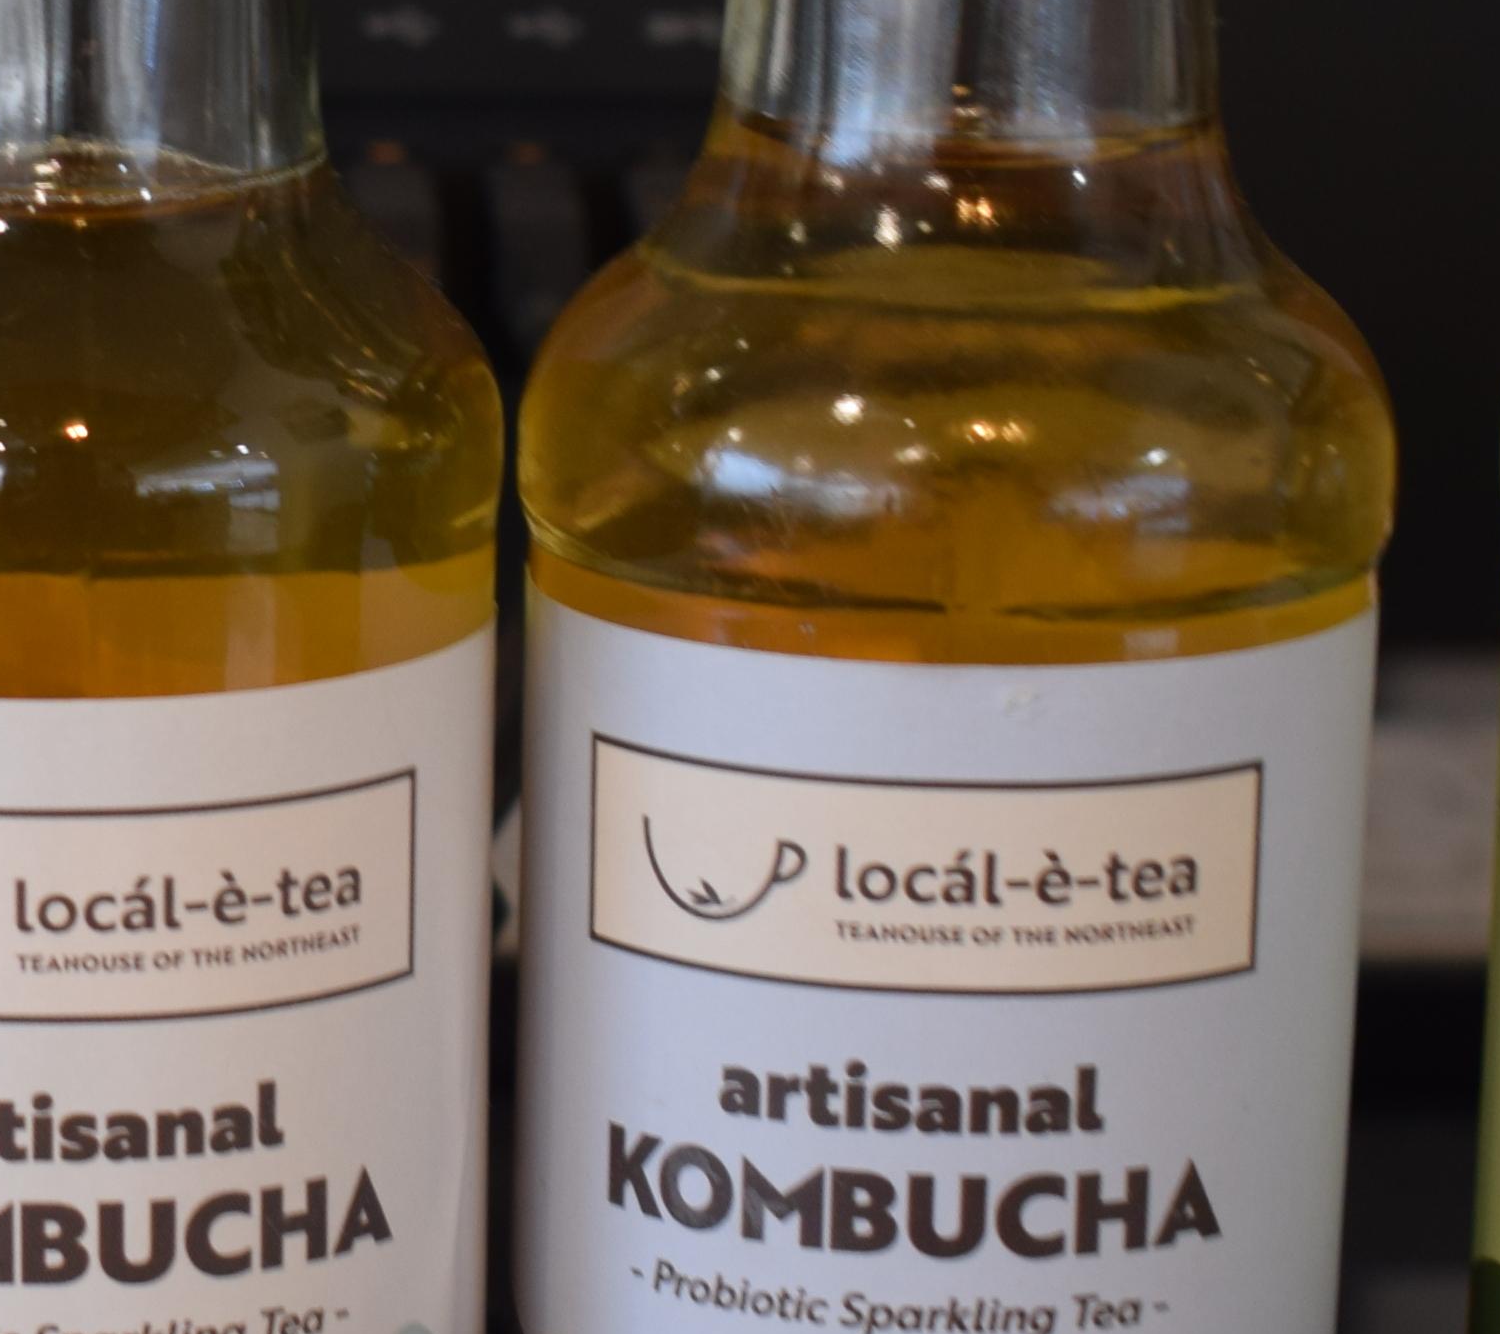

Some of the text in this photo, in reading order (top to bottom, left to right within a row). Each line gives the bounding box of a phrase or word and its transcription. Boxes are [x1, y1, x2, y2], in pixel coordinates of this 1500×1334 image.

[14, 866, 363, 935] locál-è-tea
[834, 845, 1199, 909] locál-è-tea
[17, 926, 361, 975] TEAHOUSE OF THE NORTHEAST
[836, 917, 1194, 947] TEAHOUSE OF THE NORTHEAST
[719, 1060, 1104, 1135] artisanal
[607, 1120, 1222, 1257] KOMBUCHA
[653, 1259, 829, 1328] Probiotic
[1072, 1294, 1142, 1329] Tea
